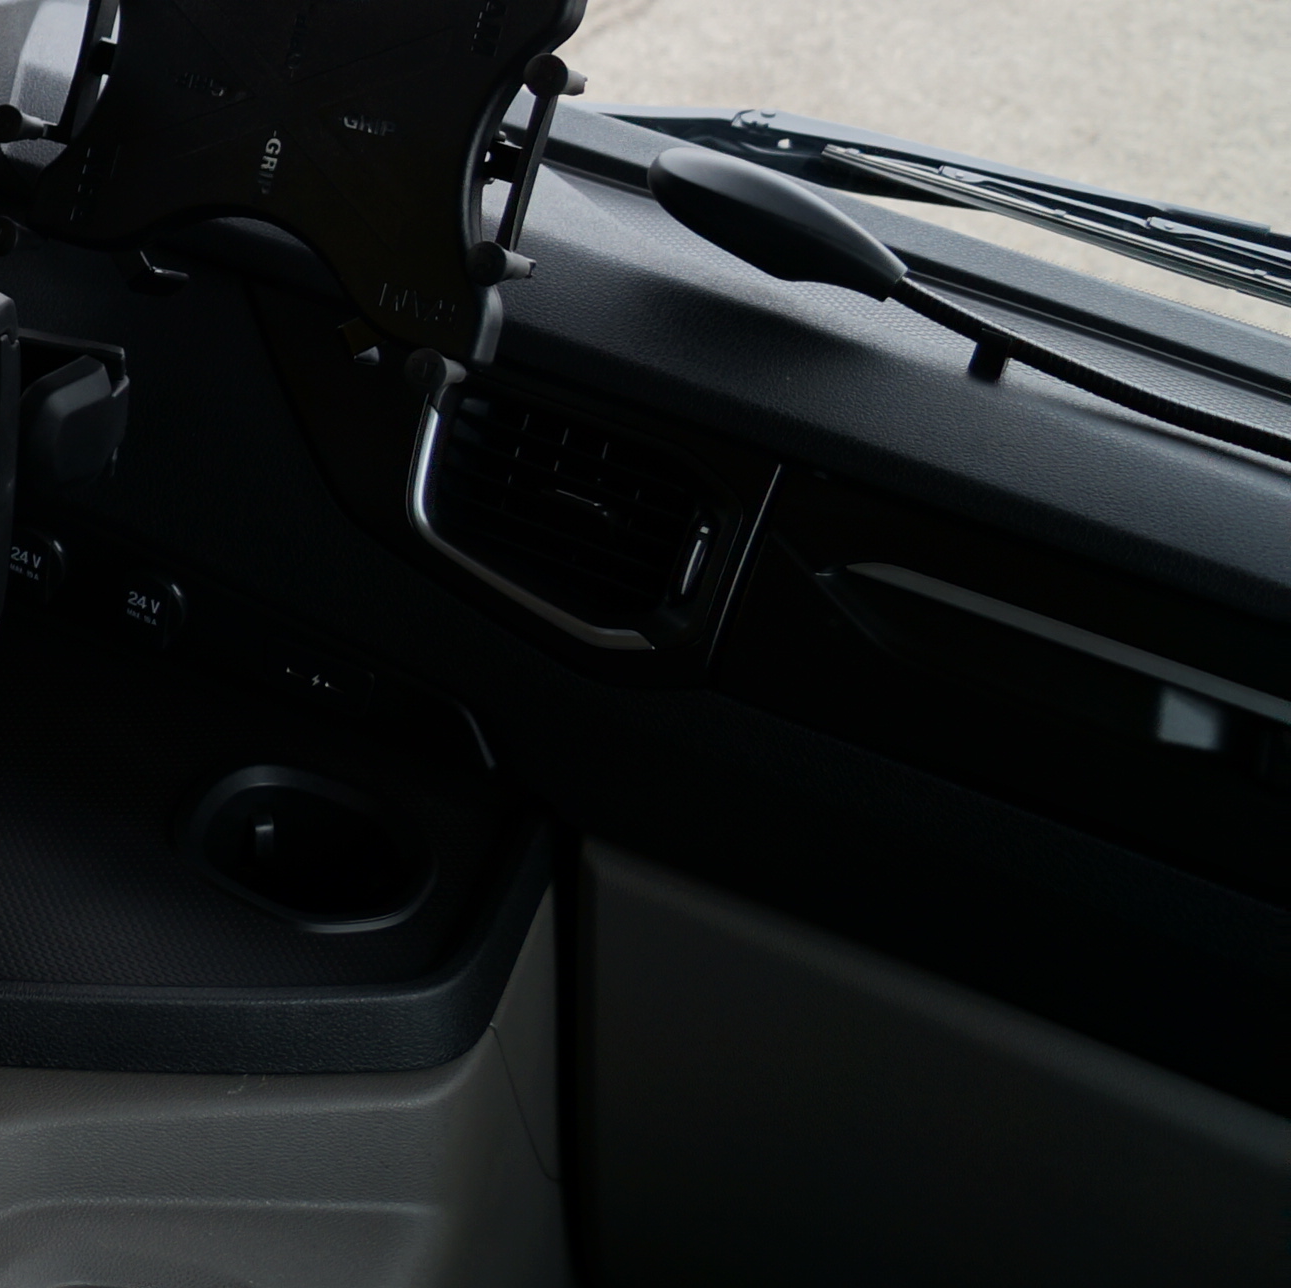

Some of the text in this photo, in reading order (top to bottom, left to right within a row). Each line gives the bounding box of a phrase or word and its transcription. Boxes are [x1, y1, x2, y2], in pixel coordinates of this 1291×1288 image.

[10, 545, 42, 569] 24 V
[126, 590, 161, 615] 24 V
